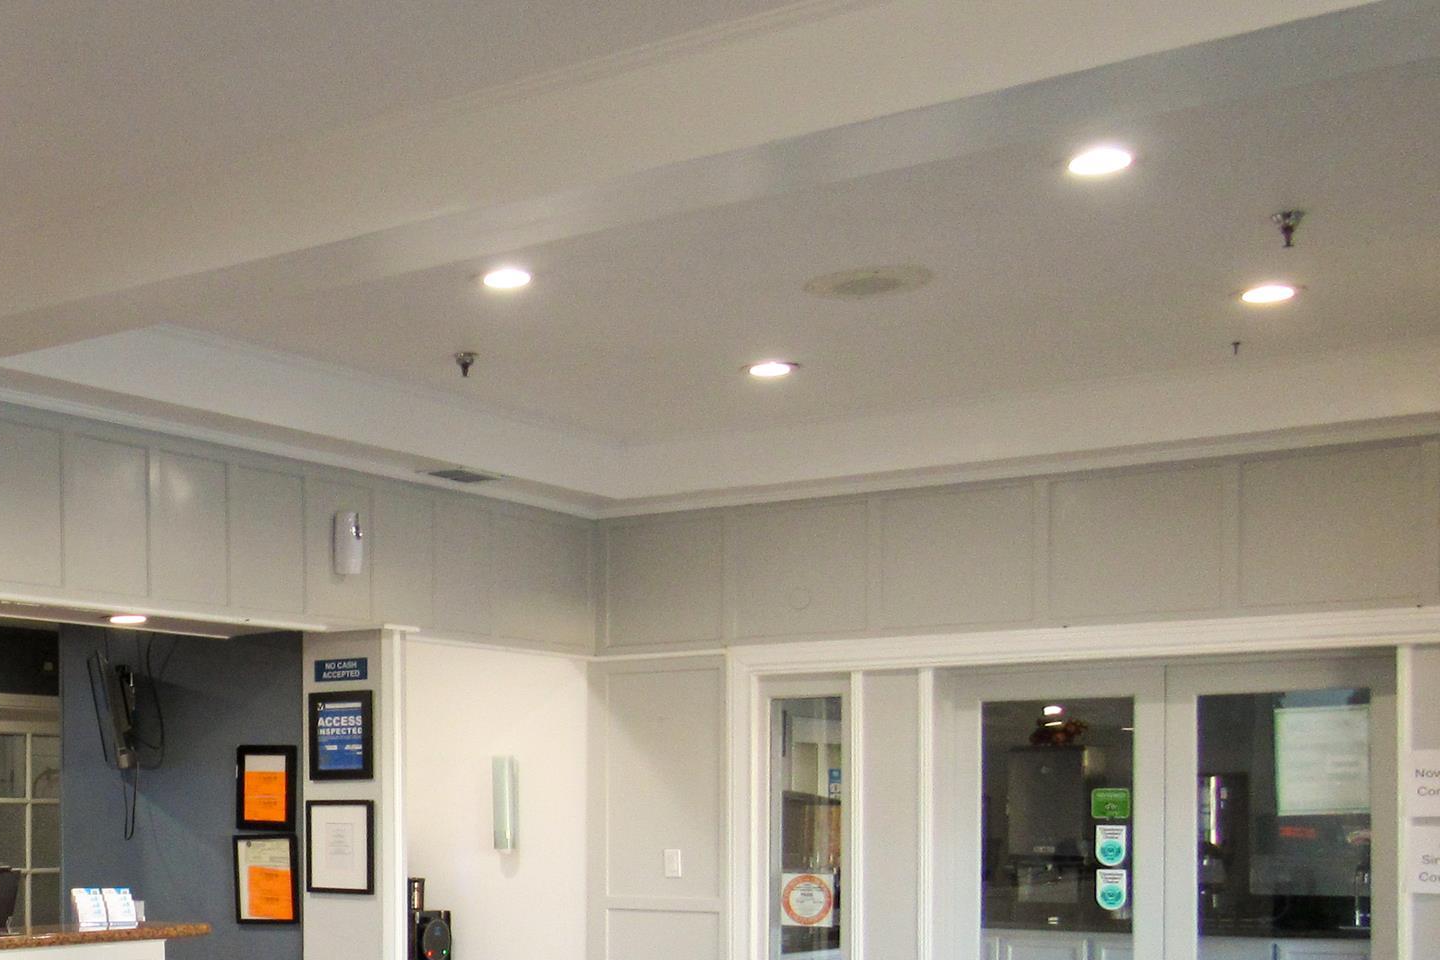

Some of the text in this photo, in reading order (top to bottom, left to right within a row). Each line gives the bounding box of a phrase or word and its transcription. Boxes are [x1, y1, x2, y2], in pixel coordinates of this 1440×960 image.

[325, 660, 358, 670] NO CASH
[322, 670, 360, 678] ACCEPTED
[317, 715, 362, 727] ACCESS
